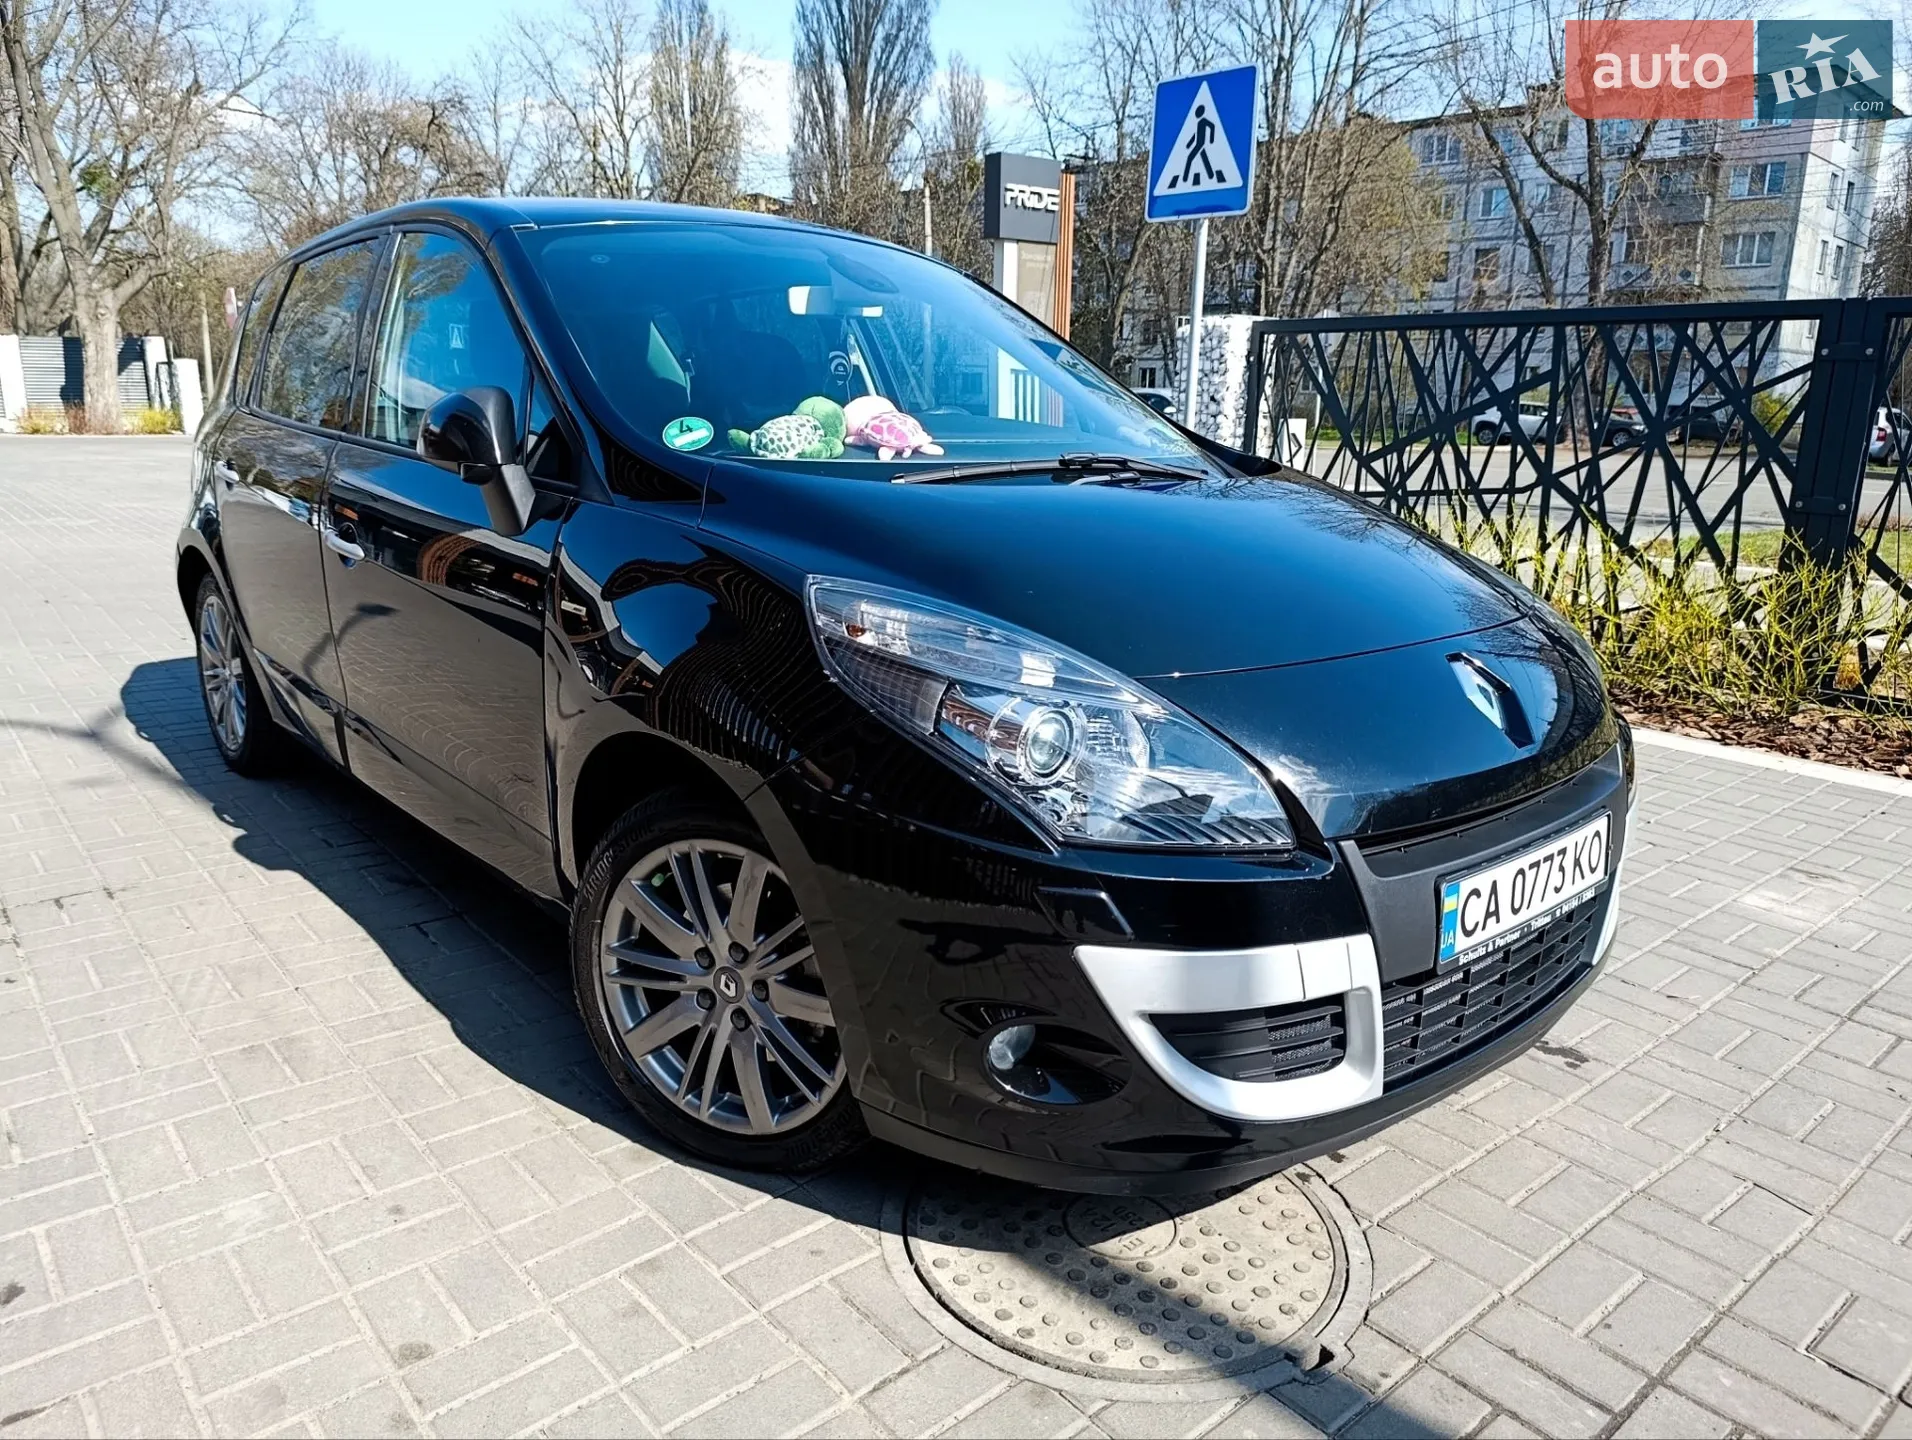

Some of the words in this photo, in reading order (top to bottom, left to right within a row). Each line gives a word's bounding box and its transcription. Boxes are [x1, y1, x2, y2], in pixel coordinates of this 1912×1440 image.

[1005, 183, 1060, 211] PRIDE
[679, 419, 693, 433] 4
[1460, 879, 1501, 938] CA
[1510, 846, 1568, 916] 0773
[1572, 829, 1602, 886] KO
[1441, 929, 1455, 948] UA
[1494, 930, 1521, 948] Partner
